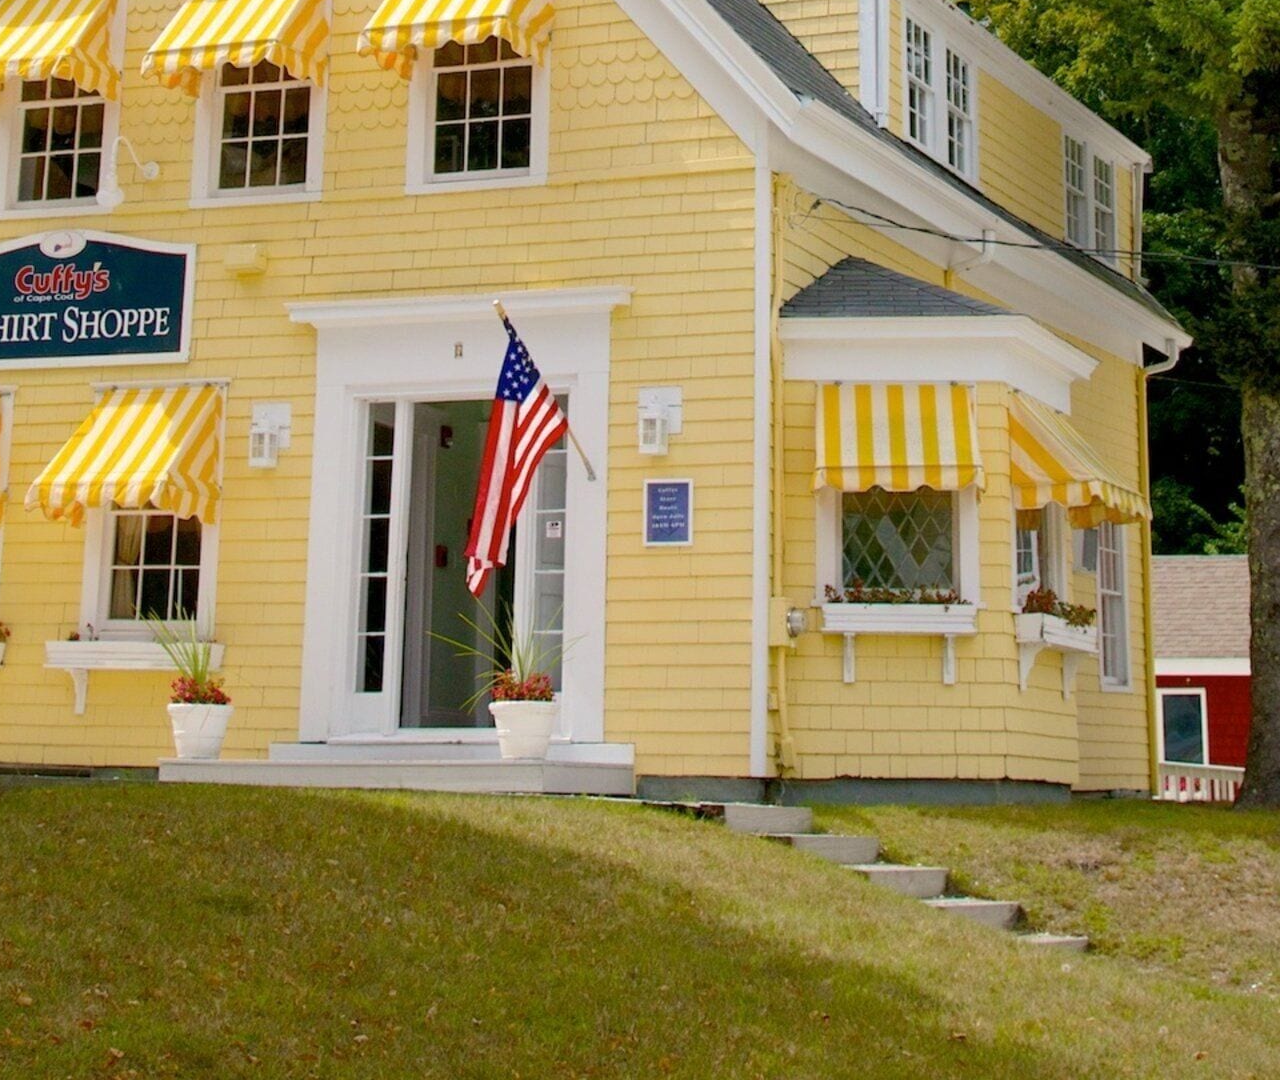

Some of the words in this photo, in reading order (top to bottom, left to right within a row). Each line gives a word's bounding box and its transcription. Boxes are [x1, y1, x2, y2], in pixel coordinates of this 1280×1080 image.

[14, 295, 24, 303] of
[26, 294, 52, 303] Cape
[54, 293, 74, 301] Cod
[15, 261, 110, 300] Cuffy's
[62, 306, 170, 343] SHOPPE
